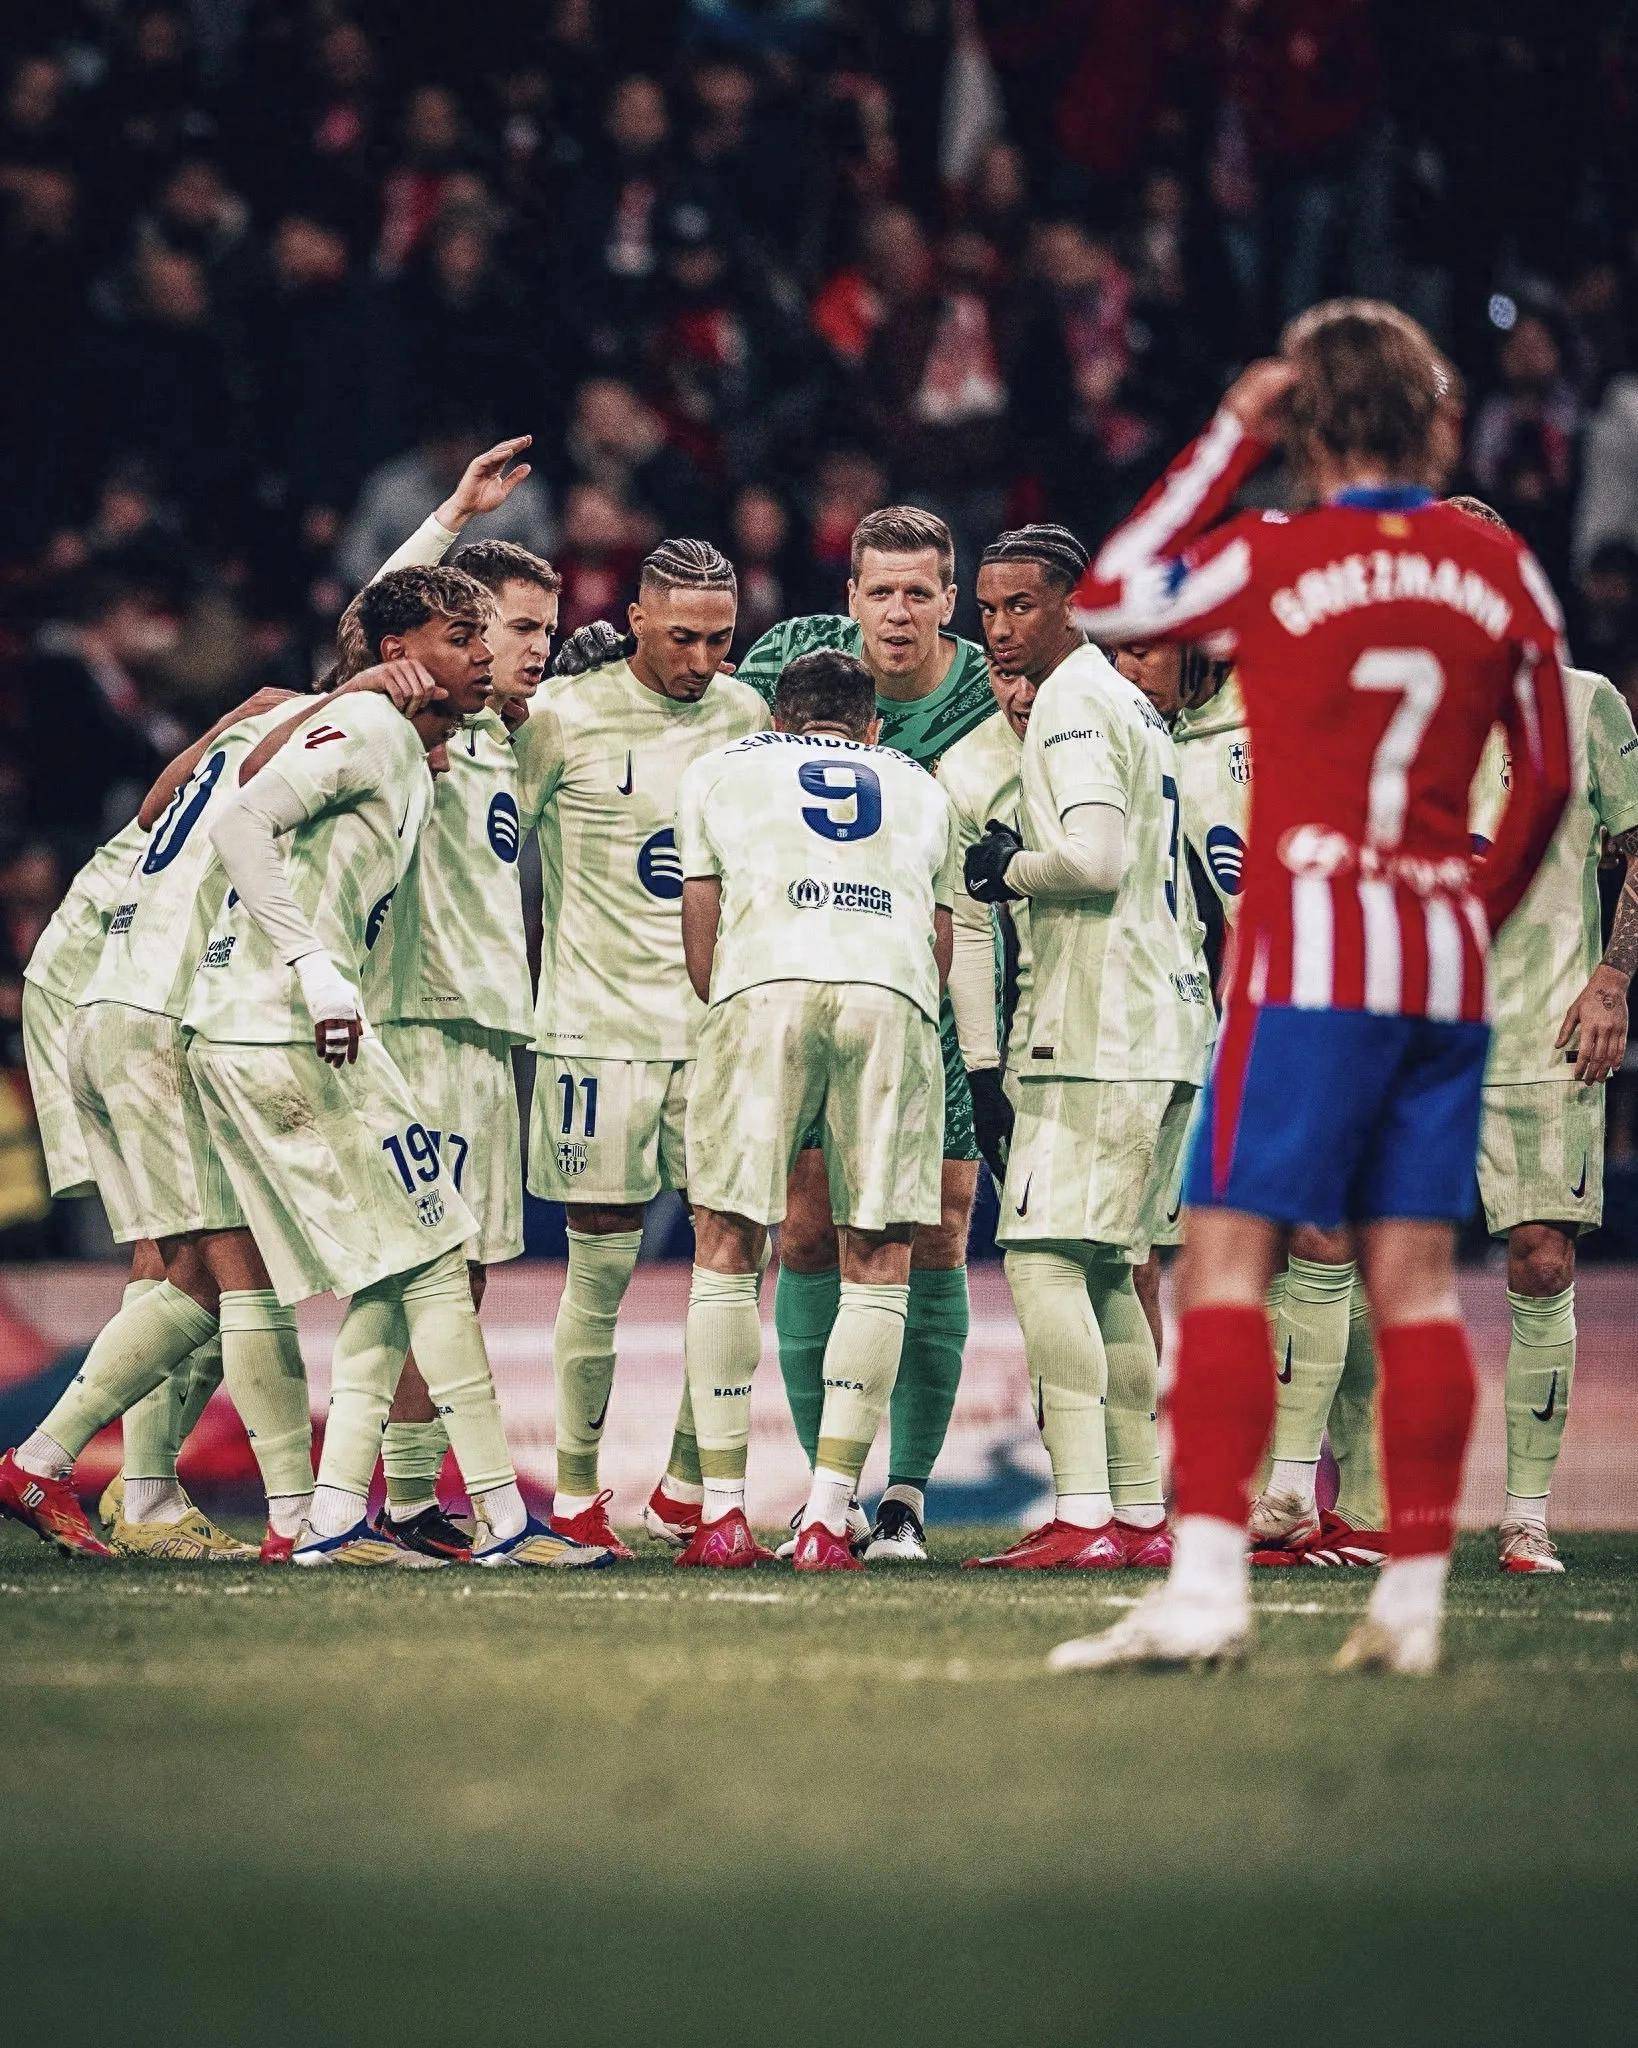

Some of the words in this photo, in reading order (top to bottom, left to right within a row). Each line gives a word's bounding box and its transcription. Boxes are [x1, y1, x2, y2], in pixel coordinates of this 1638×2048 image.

[1044, 730, 1093, 749] AMBILIGHT
[1347, 646, 1446, 852] 7
[798, 759, 882, 842] 9
[833, 882, 891, 902] UNHCR
[833, 894, 892, 913] ACNUR
[557, 1073, 599, 1138] 11
[382, 1123, 441, 1195] 19
[426, 1130, 470, 1194] 7
[19, 1481, 46, 1509] 10
